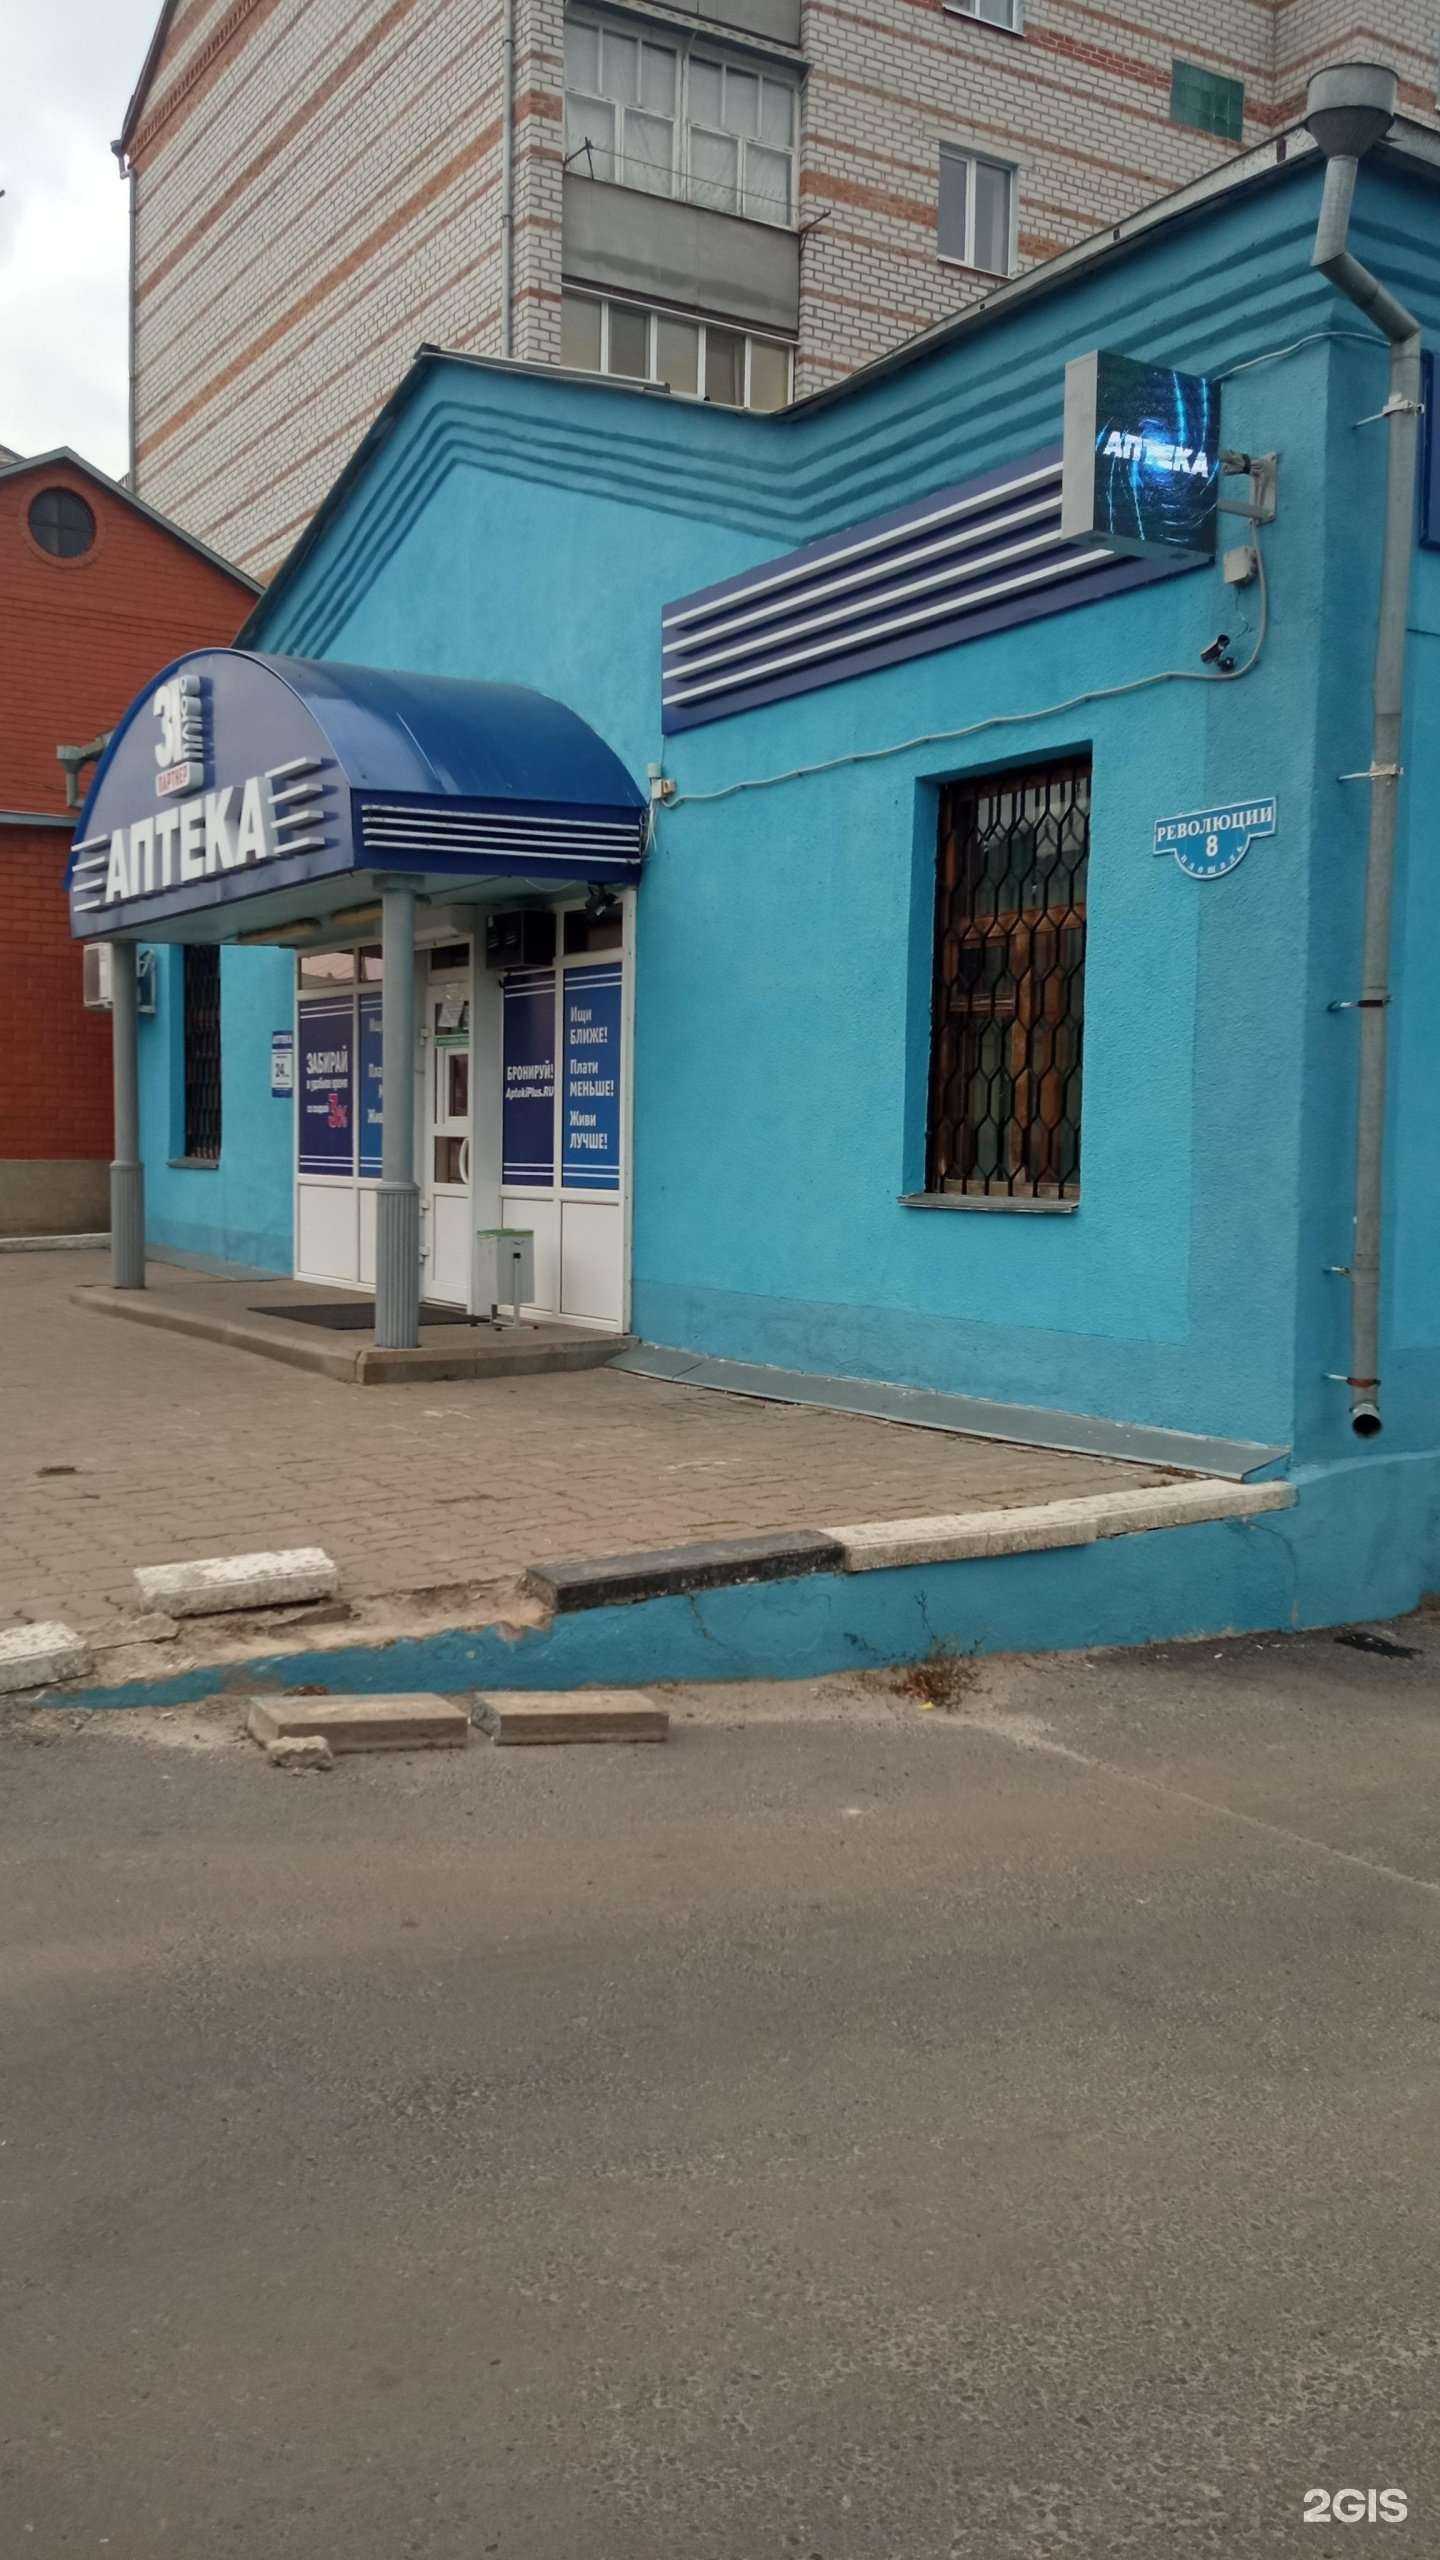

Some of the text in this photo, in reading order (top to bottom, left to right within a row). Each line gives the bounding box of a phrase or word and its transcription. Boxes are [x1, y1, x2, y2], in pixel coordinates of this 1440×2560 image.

[1103, 430, 1209, 478] АПТЕКА
[1157, 806, 1273, 842] РЕВОЛЮЦИИ
[105, 776, 270, 903] АПТЕКА
[1206, 835, 1218, 857] 8
[570, 1006, 592, 1024] Ищи
[570, 1026, 608, 1045] БЛИЖЕ!
[306, 1044, 348, 1075] ЗАБИРАЙ
[570, 1059, 599, 1074] Плати
[507, 1060, 554, 1081] БРОНИРУЙ!
[569, 1080, 614, 1097] МЕНЬШЕ!
[569, 1110, 597, 1126] Живи
[569, 1133, 608, 1150] ЛУЧШЕ!
